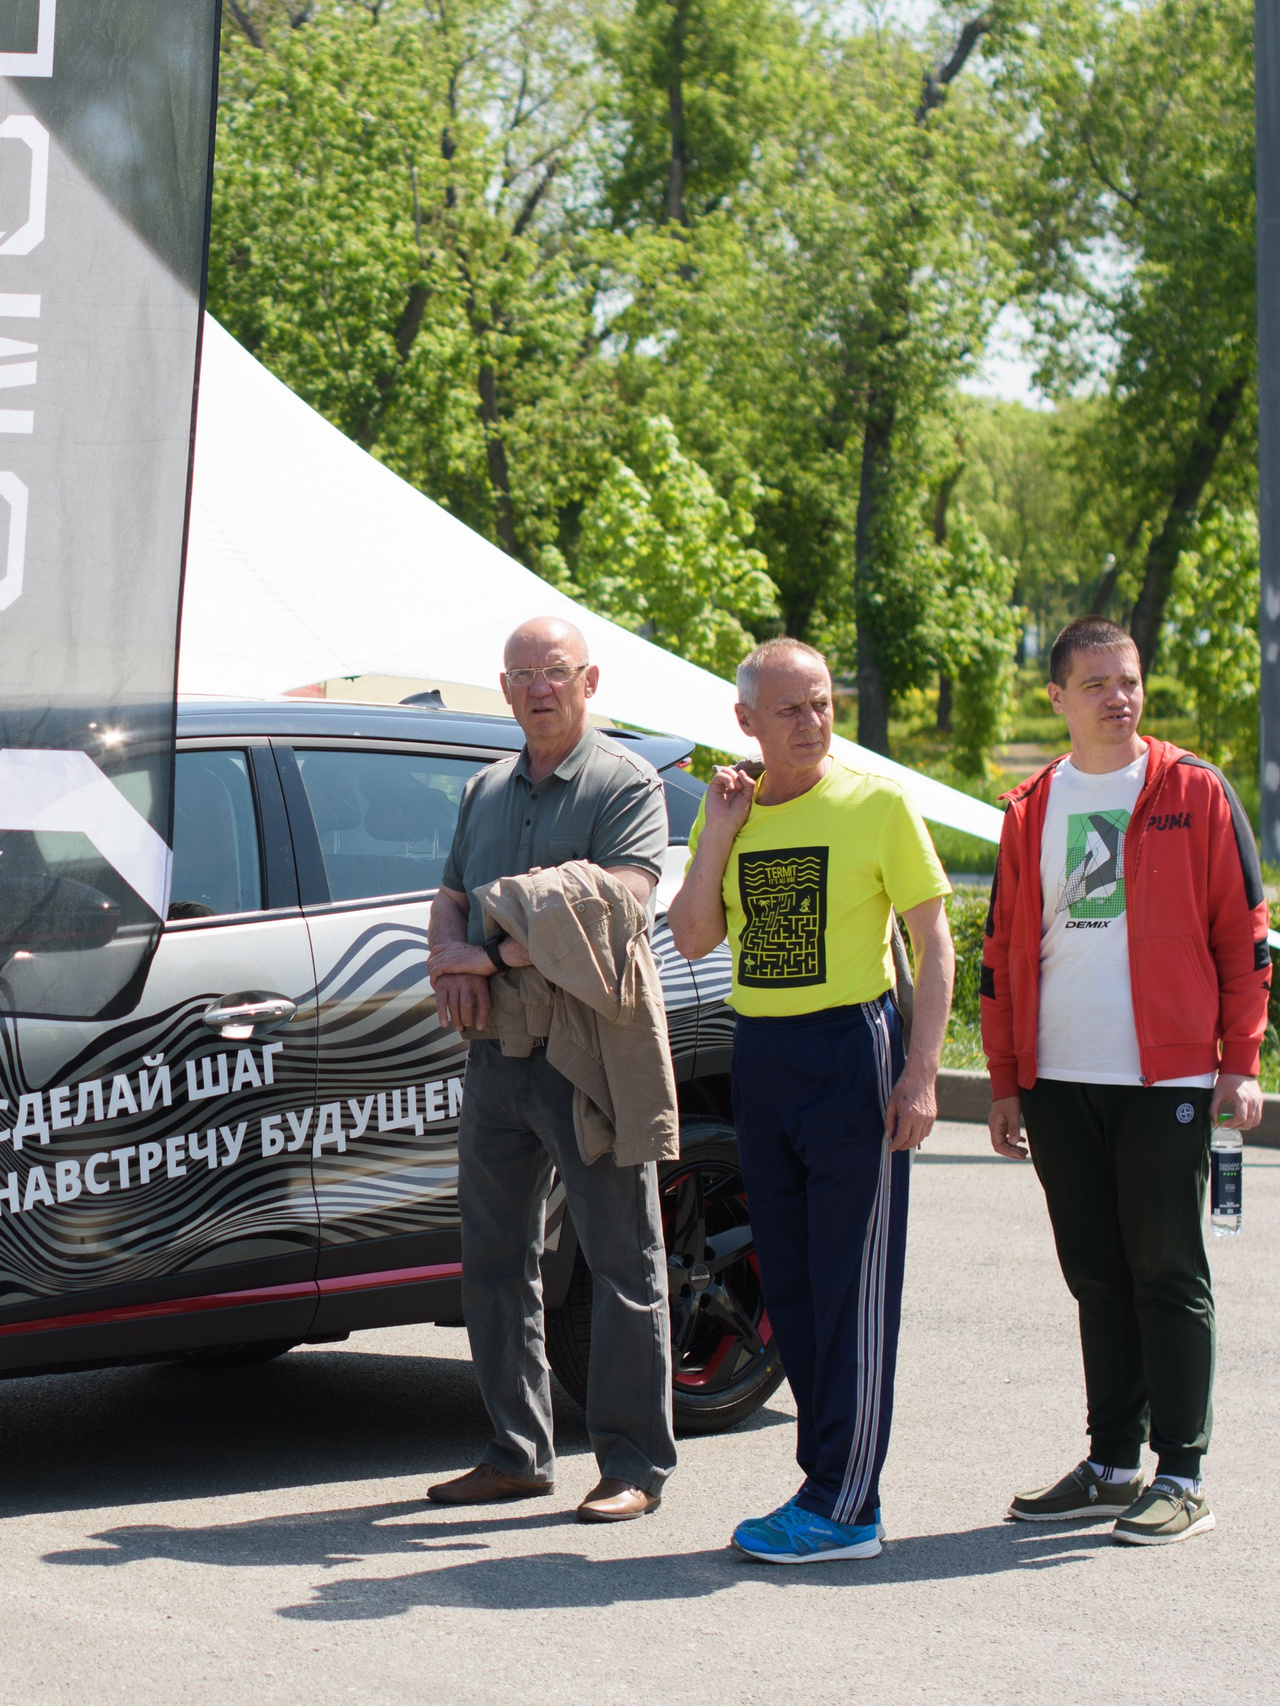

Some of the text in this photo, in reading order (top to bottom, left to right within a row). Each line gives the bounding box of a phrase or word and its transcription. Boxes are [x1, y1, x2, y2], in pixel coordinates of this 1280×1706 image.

[1146, 812, 1193, 831] PUMA
[765, 865, 798, 879] TERMIT
[1065, 920, 1112, 929] DEMIX
[185, 1042, 284, 1101] ШАГ
